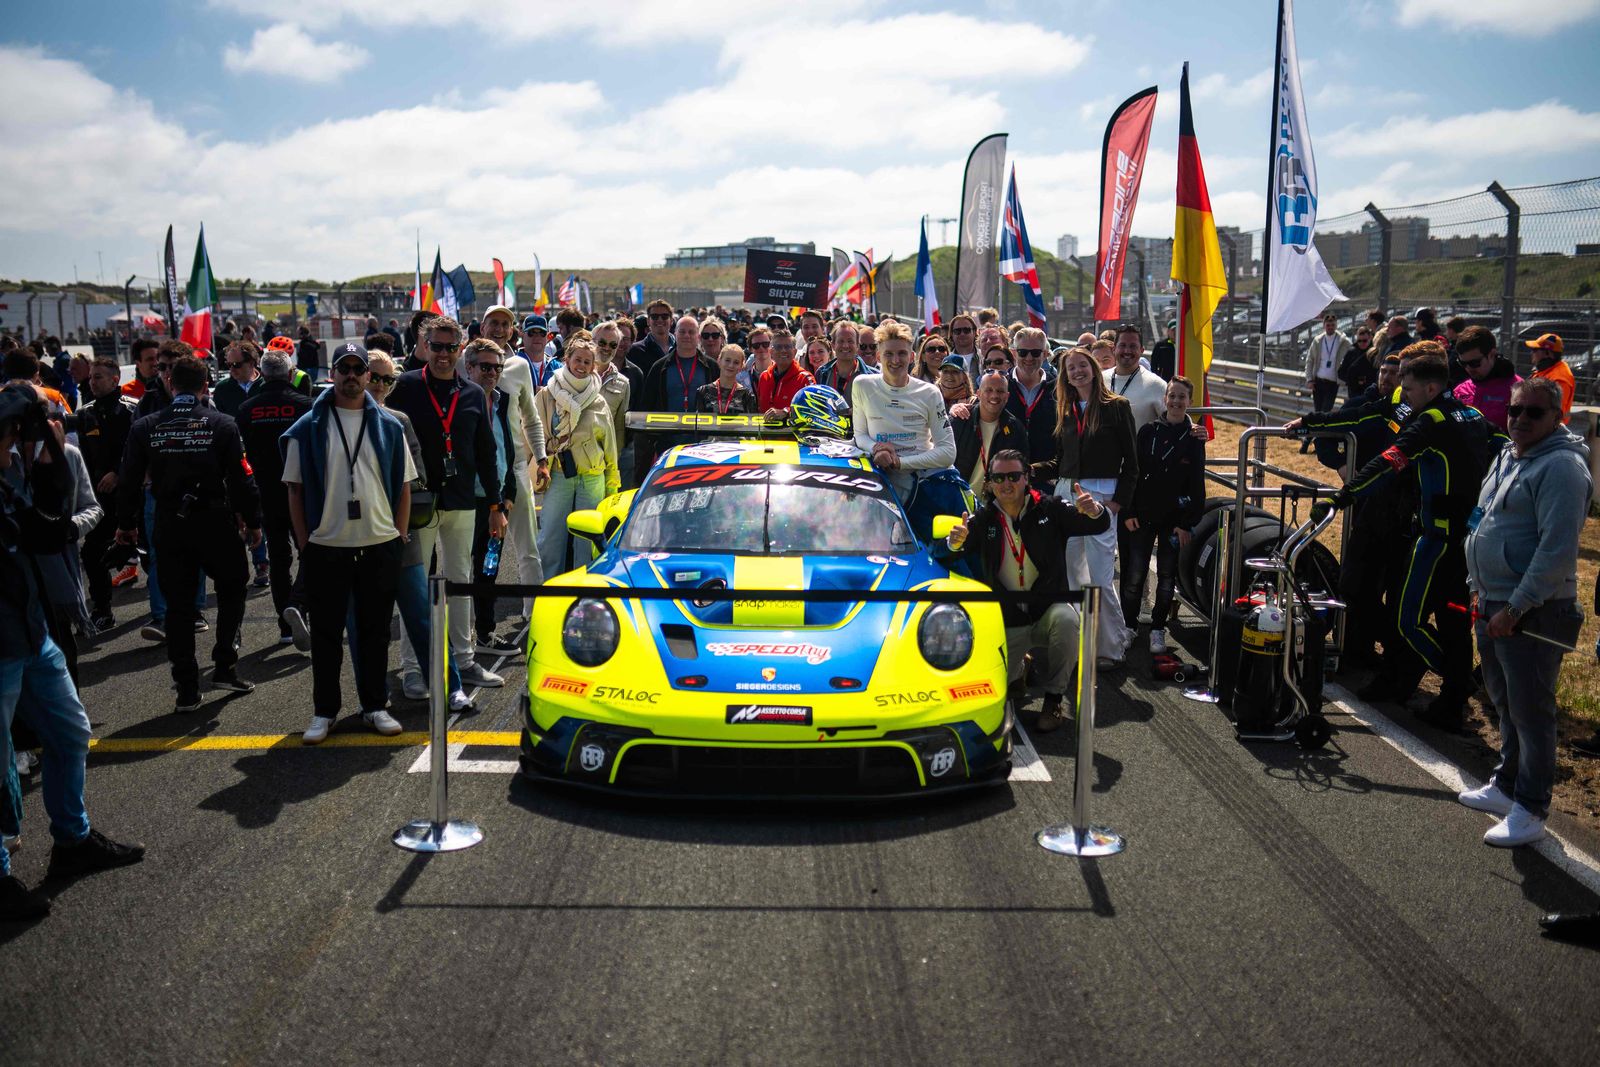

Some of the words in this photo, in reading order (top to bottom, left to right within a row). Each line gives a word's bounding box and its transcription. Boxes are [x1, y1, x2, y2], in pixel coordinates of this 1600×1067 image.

[979, 180, 989, 210] SPORT
[975, 210, 986, 255] CONCEPT
[758, 278, 796, 287] CHAMPIONSHIP
[797, 281, 816, 289] LEADER
[768, 288, 805, 300] SILVER
[346, 343, 357, 352] LA
[251, 405, 295, 420] SRO
[652, 464, 761, 488] GT
[541, 677, 588, 694] PIRELLI
[735, 682, 802, 691] SIEGERDESIGNS
[948, 683, 993, 699] PIRELLI
[592, 685, 662, 704] STALOC
[874, 690, 942, 707] STALOC
[760, 707, 787, 715] ASSETTO
[786, 708, 807, 716] CORSA
